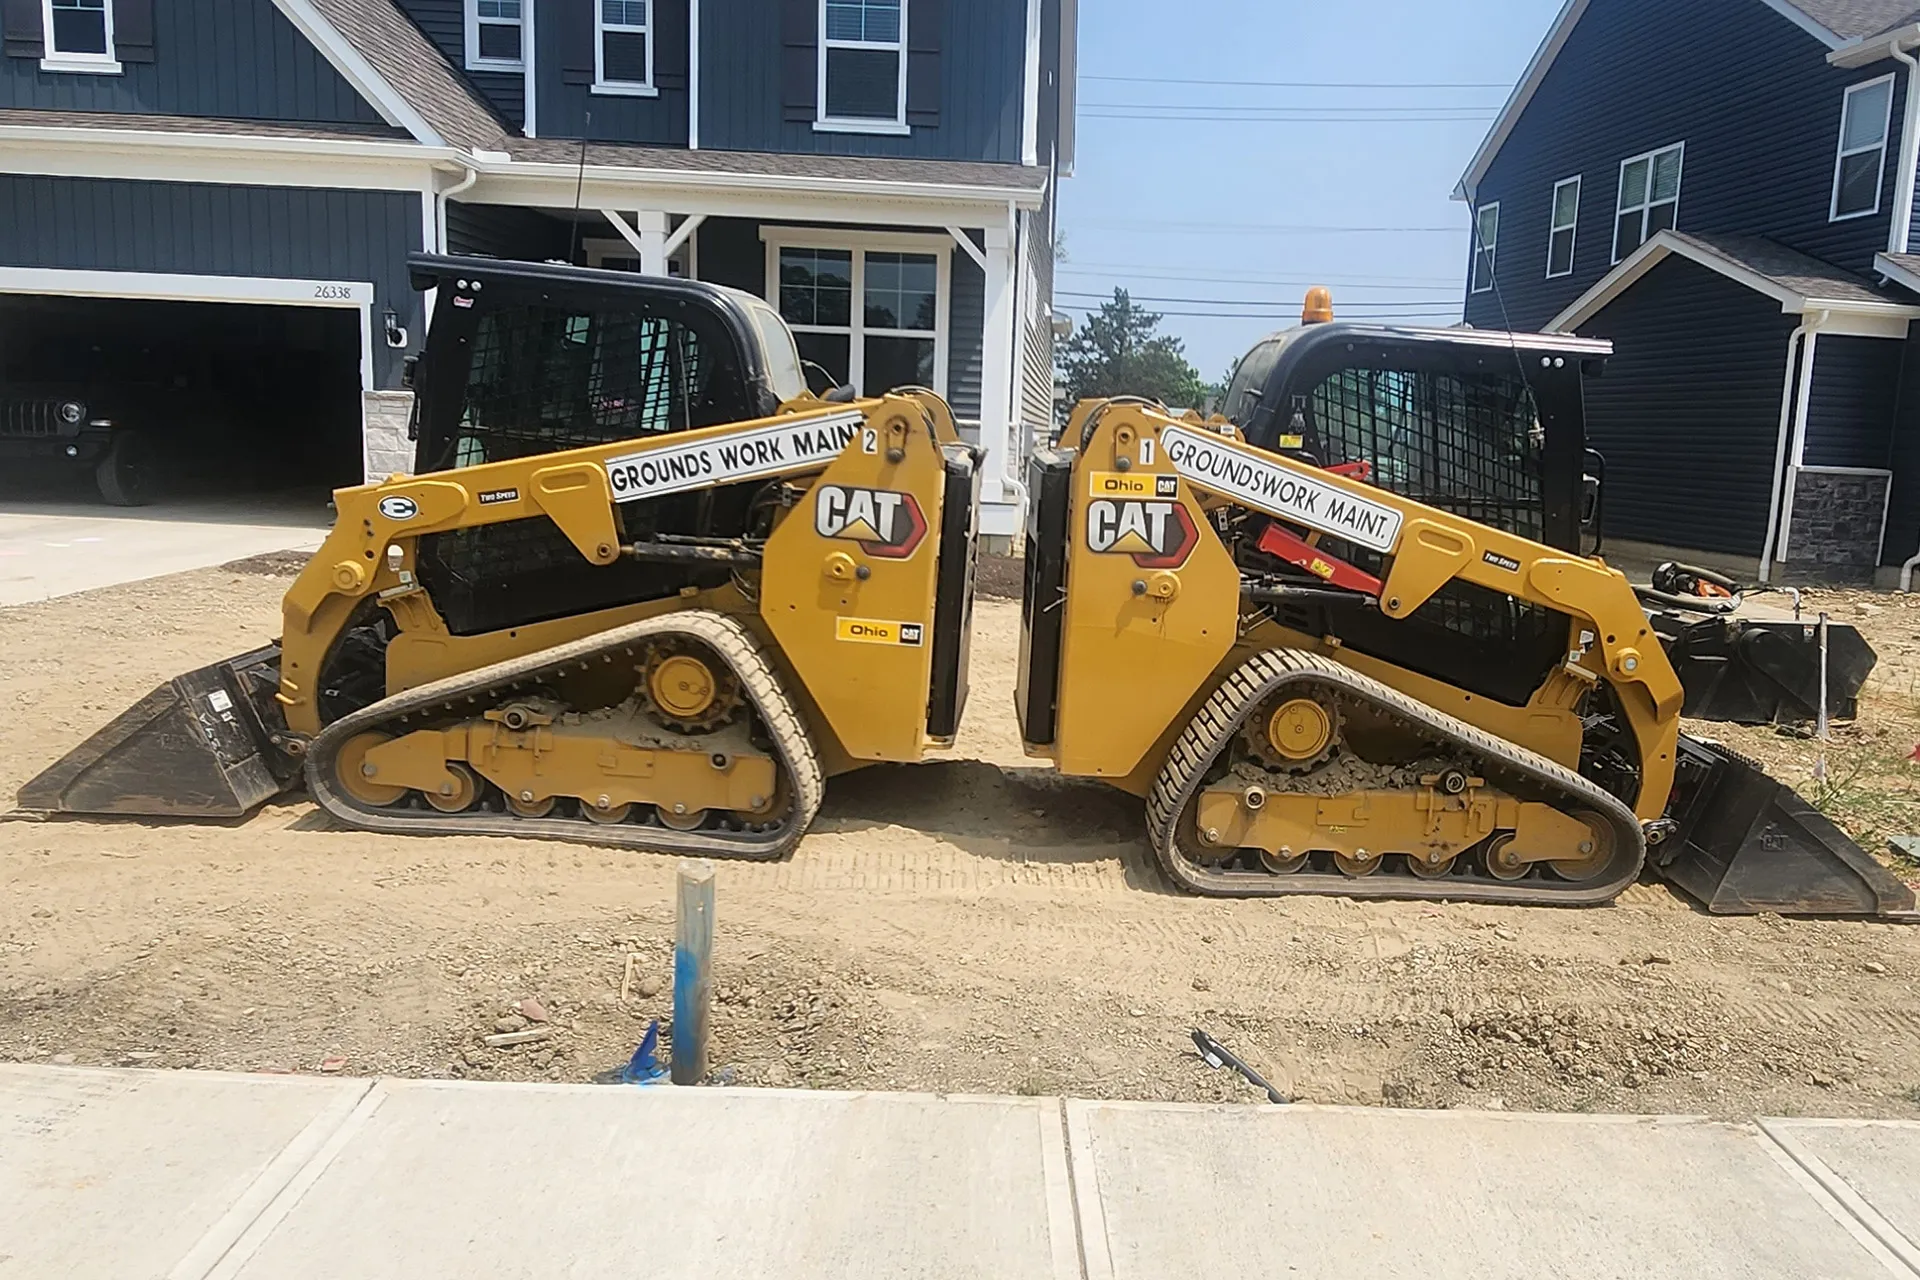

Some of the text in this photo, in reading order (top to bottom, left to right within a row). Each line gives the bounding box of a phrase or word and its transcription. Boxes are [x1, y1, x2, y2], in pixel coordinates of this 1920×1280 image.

[314, 285, 351, 299] 26338
[866, 429, 876, 452] 2
[1144, 440, 1151, 463] 1
[611, 451, 712, 492] GROUNDS
[718, 436, 785, 471] WORK
[1104, 479, 1176, 493] Ohio CAT
[1169, 439, 1388, 539] GROUNDSWORK MAINT.
[817, 486, 902, 543] CAT
[1088, 500, 1173, 553] CAT
[850, 624, 920, 640] Ohio CAT
